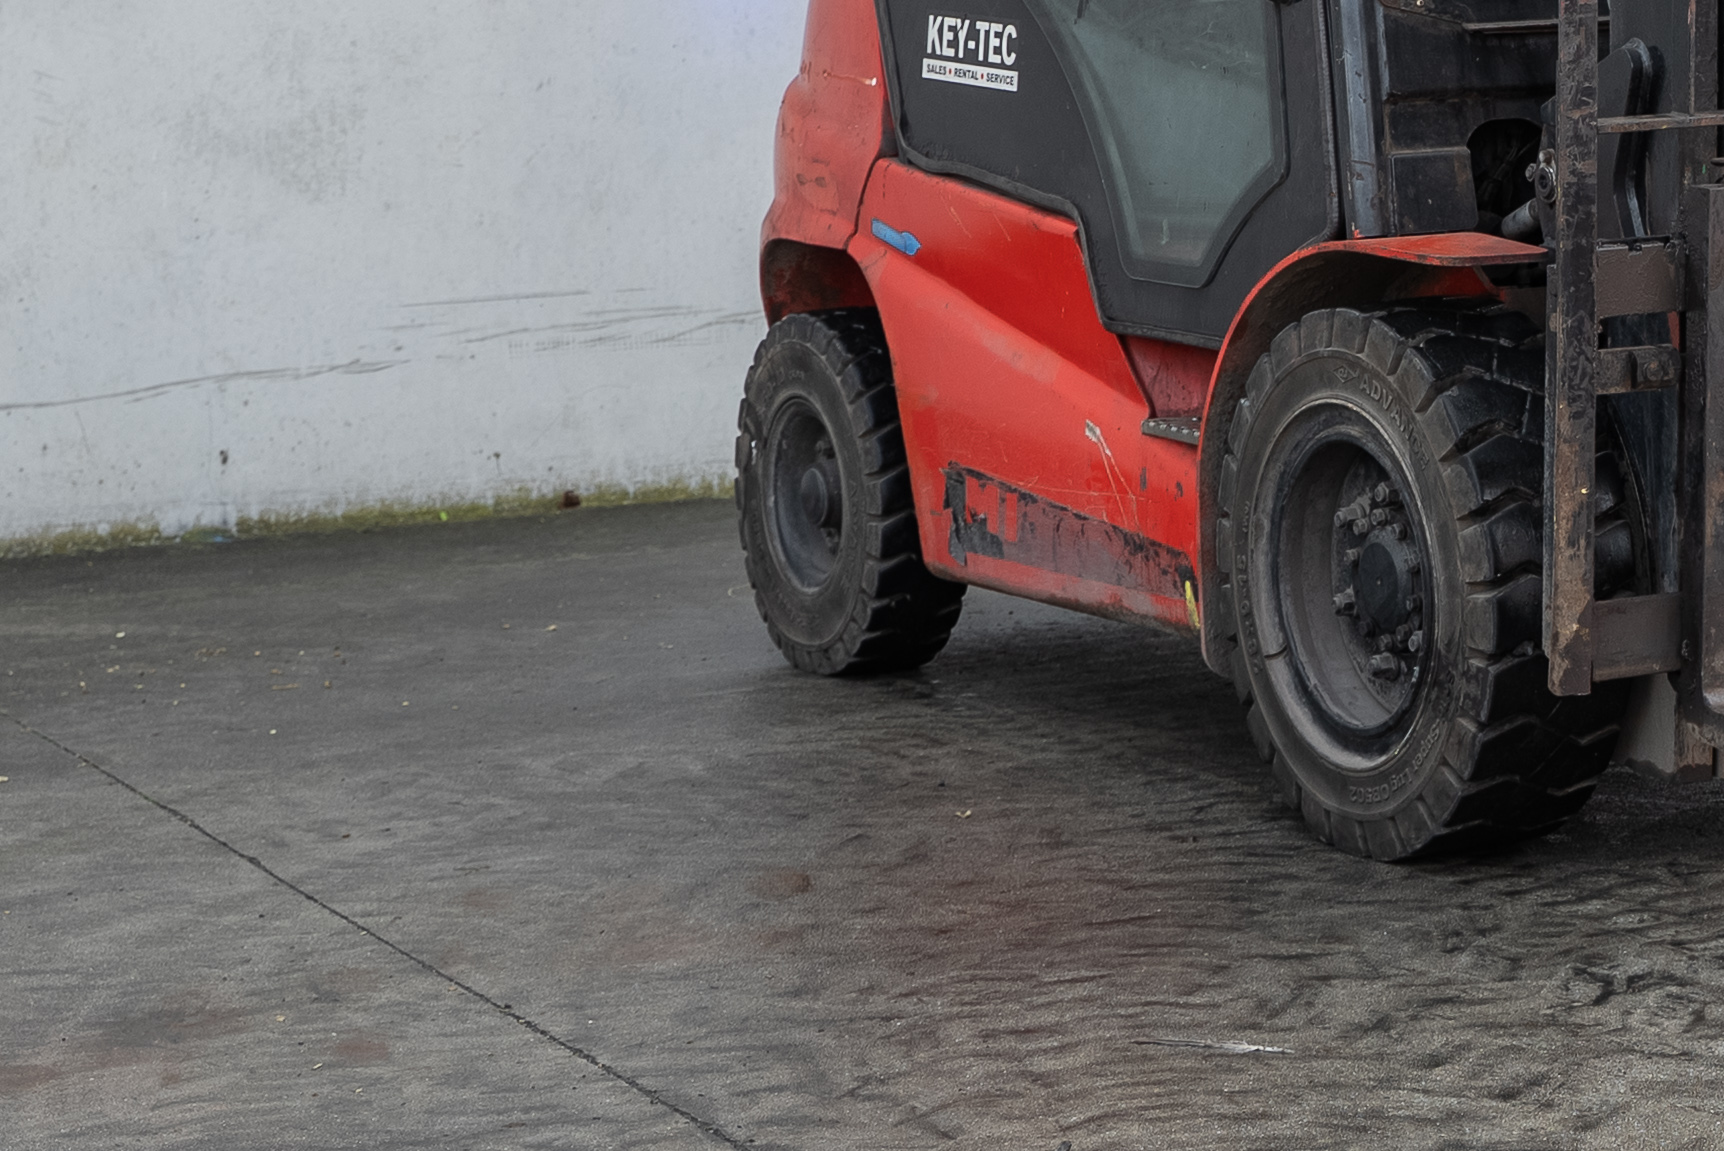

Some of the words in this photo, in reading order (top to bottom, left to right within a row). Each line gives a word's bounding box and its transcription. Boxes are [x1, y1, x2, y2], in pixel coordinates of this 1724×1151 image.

[927, 14, 1017, 66] KEY-TEC
[926, 63, 947, 76] SALES
[953, 67, 979, 81] RENTAL
[986, 72, 1015, 87] SERVICE
[1360, 373, 1430, 471] ADVANCE
[1412, 718, 1440, 772] Super
